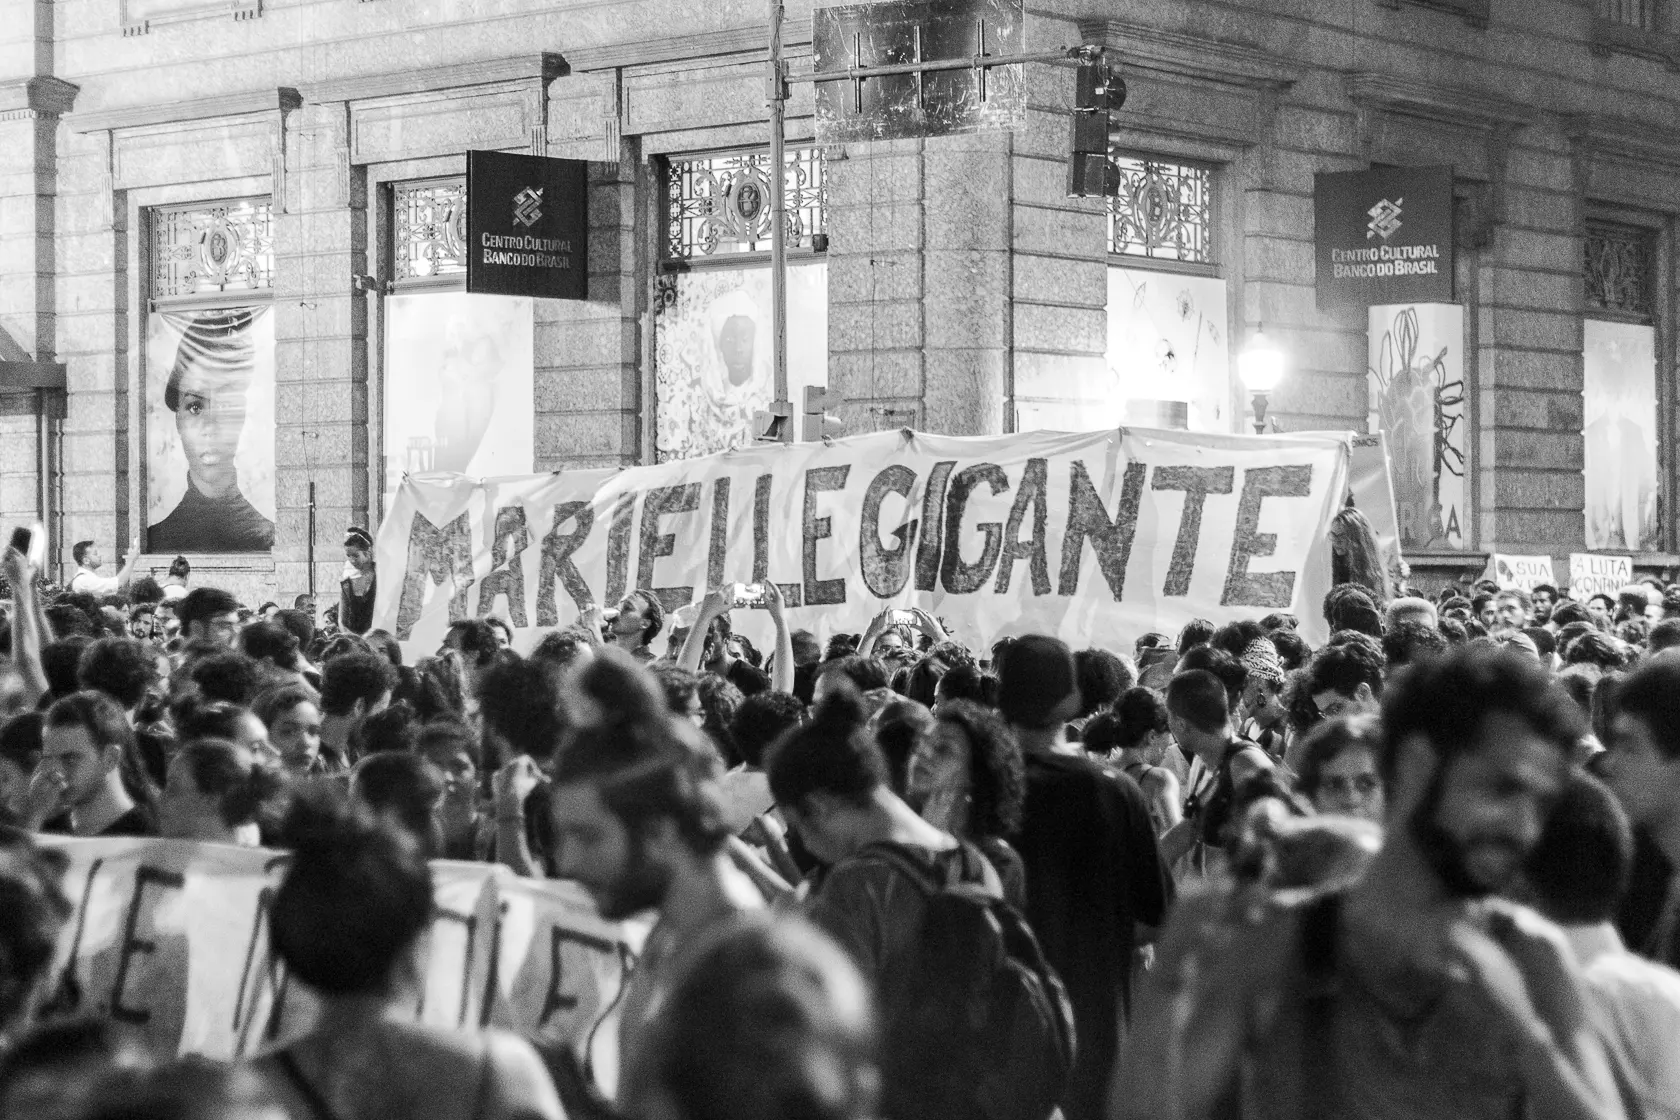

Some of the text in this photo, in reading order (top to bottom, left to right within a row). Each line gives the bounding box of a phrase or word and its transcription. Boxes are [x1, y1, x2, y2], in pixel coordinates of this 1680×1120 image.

[481, 232, 573, 253] CENTRO CULTURAL
[483, 249, 571, 269] BANCO DO BRASIL
[1331, 244, 1440, 262] CENTRO CULTURAL
[1333, 260, 1438, 278] BANCO DO BRASIL
[859, 457, 1313, 609] GIGANTE
[1516, 561, 1549, 577] SUA
[1590, 557, 1628, 577] LUTA
